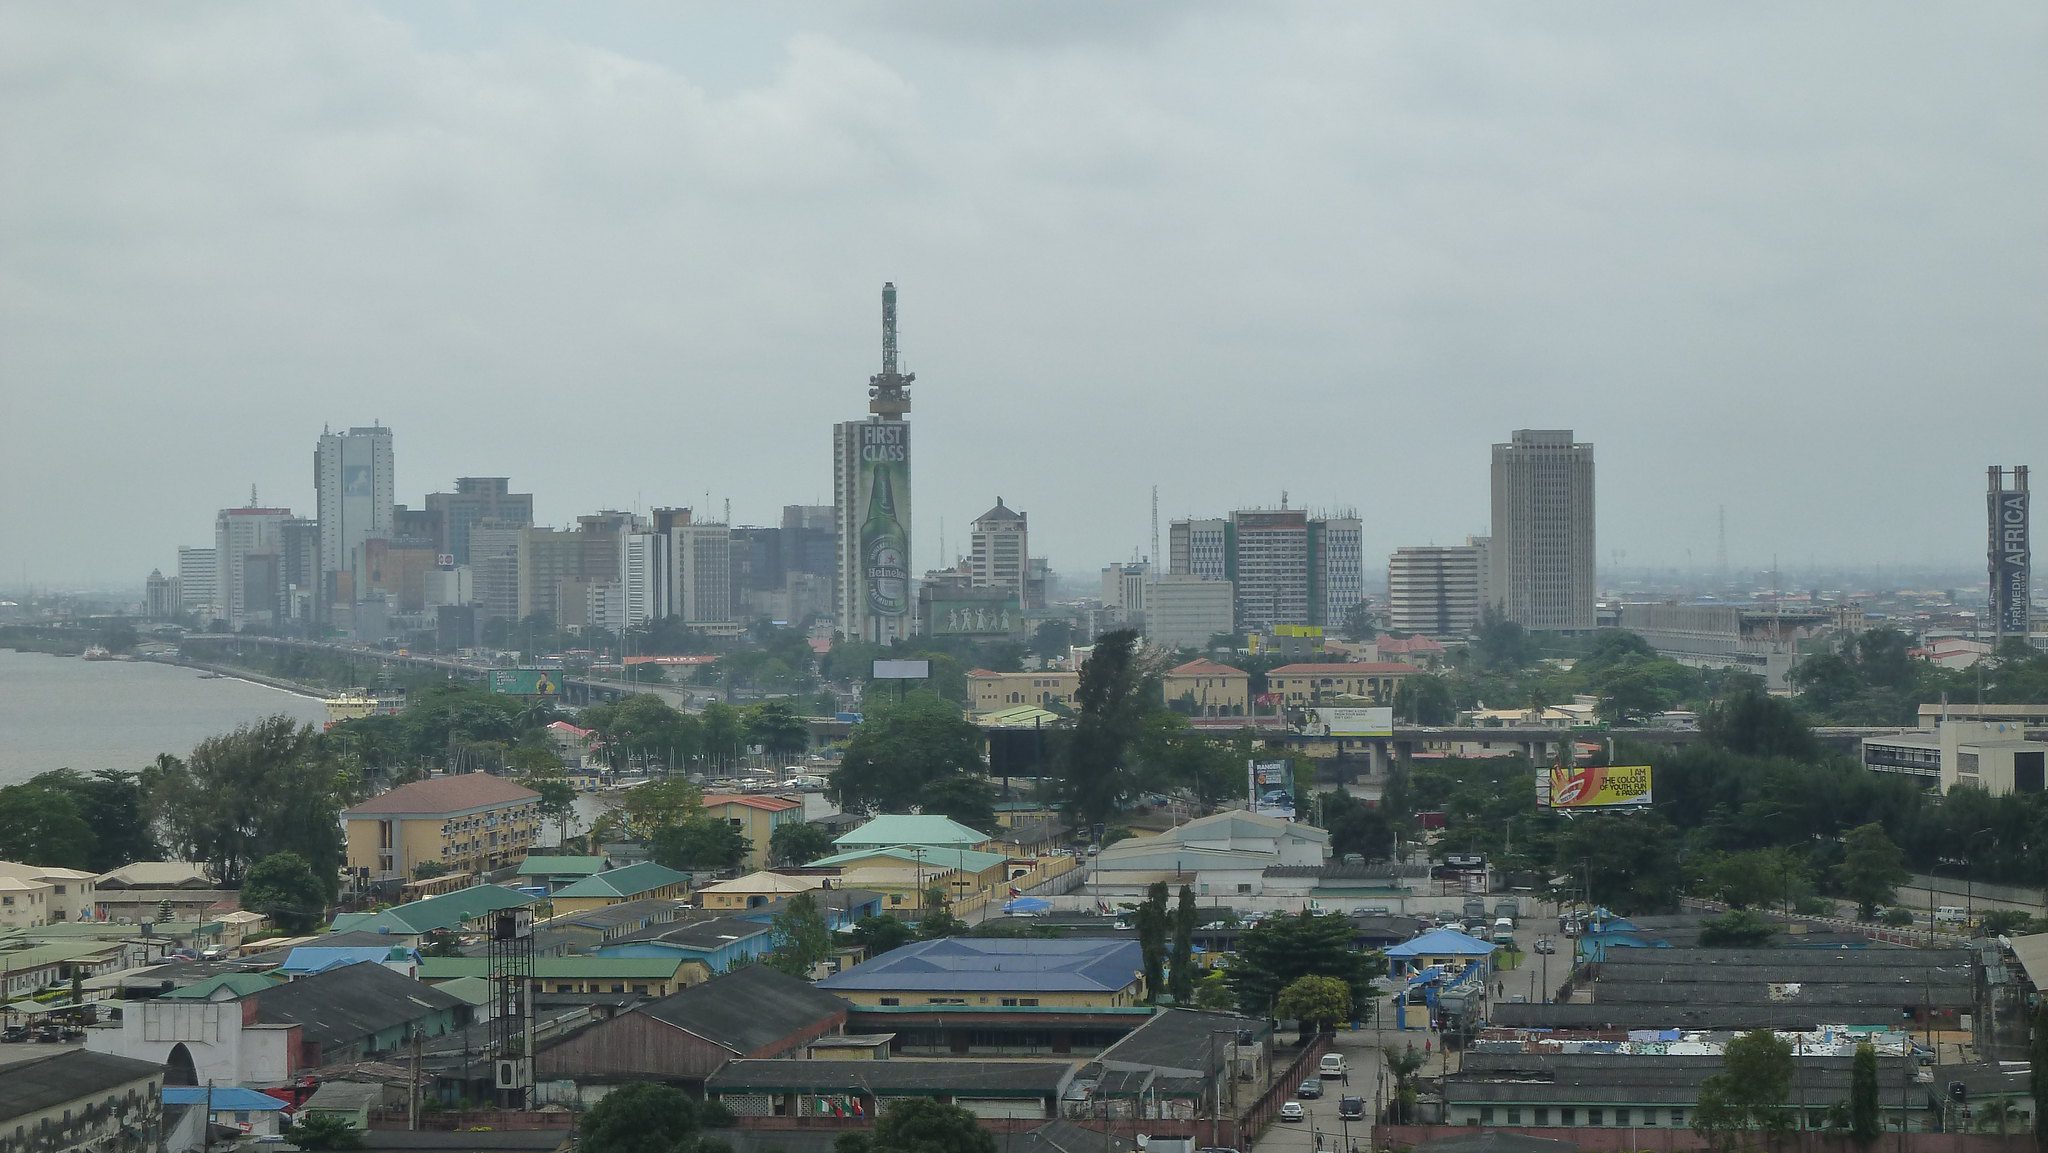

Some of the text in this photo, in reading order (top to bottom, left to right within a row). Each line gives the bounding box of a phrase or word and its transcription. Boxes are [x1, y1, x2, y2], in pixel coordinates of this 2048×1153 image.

[864, 426, 902, 444] FIRST
[863, 445, 904, 461] CLASS
[2004, 496, 2025, 567] AFRICA
[2012, 571, 2021, 626] PRIMEDIA
[1635, 768, 1646, 776] AM
